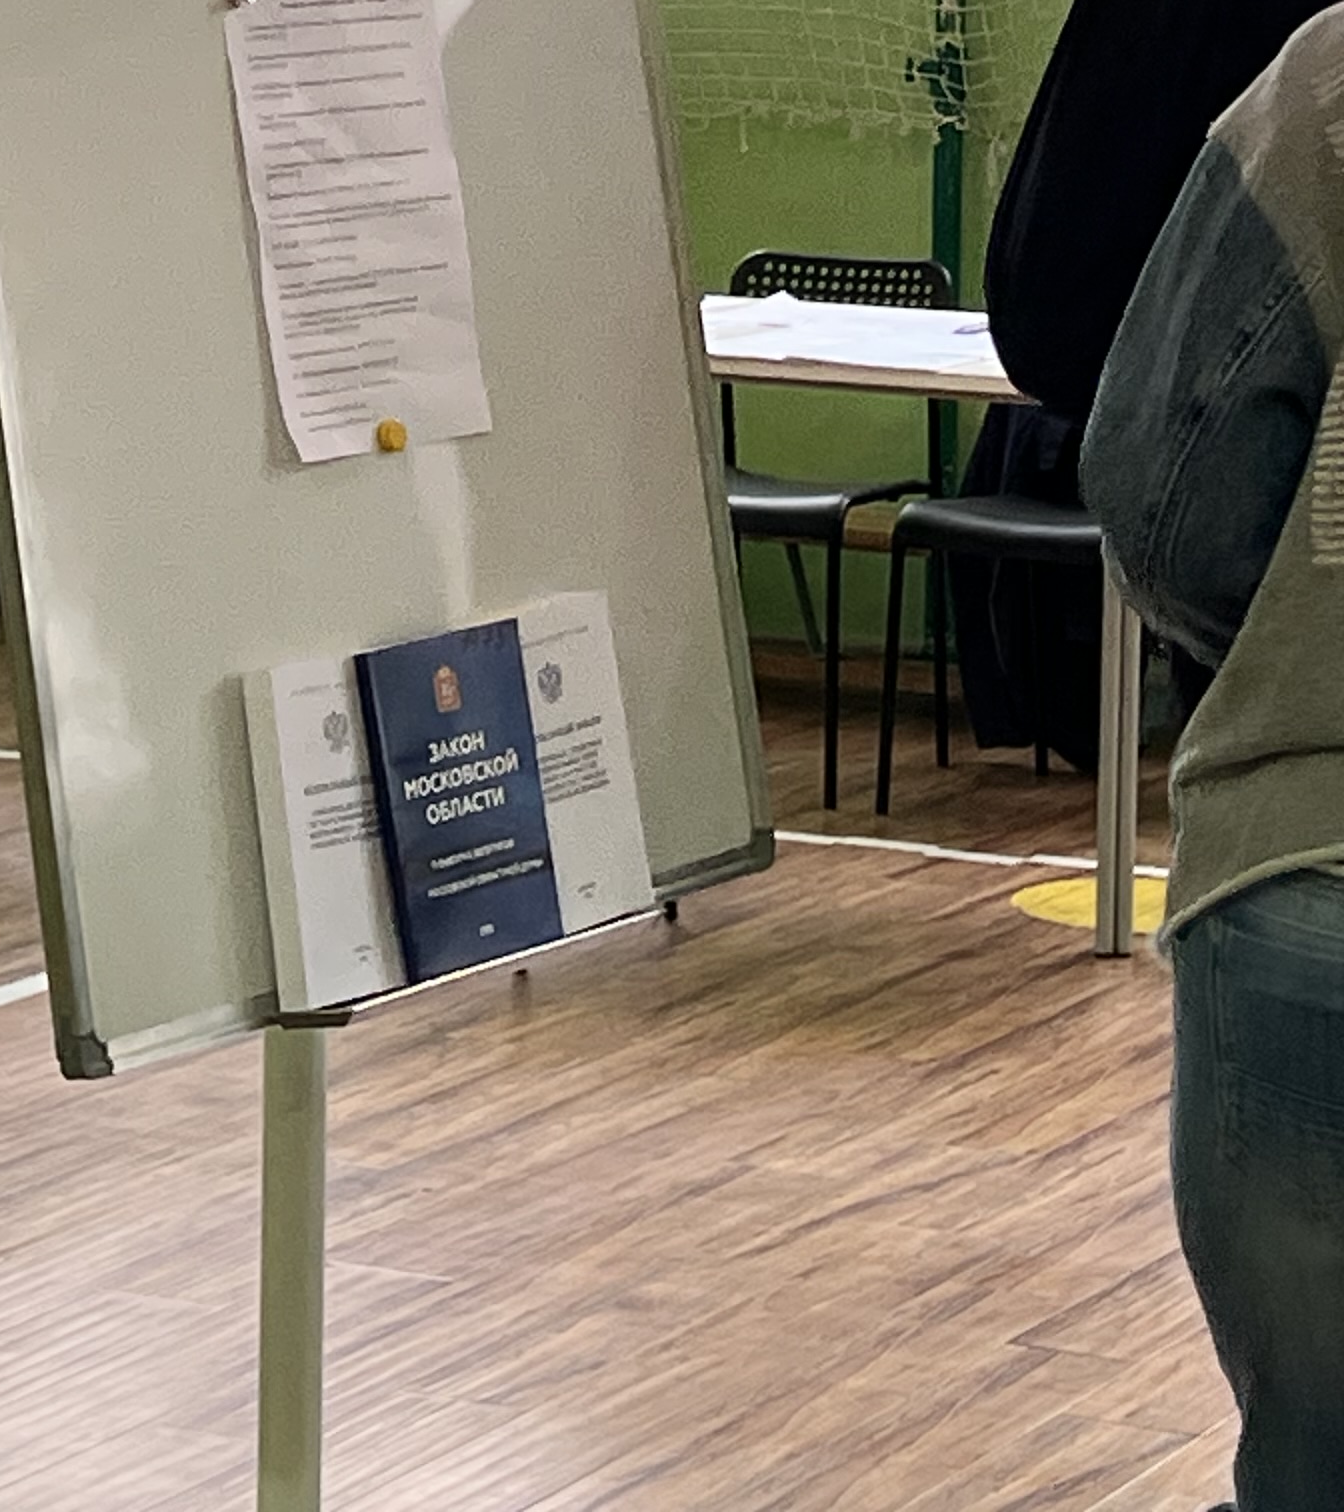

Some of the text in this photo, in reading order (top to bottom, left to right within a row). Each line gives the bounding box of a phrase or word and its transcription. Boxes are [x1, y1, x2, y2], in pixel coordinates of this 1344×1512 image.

[428, 730, 485, 764] ЗАКОН
[404, 747, 519, 801] МОСКОВСКОЙ
[426, 786, 505, 825] ОБЛАСТИ
